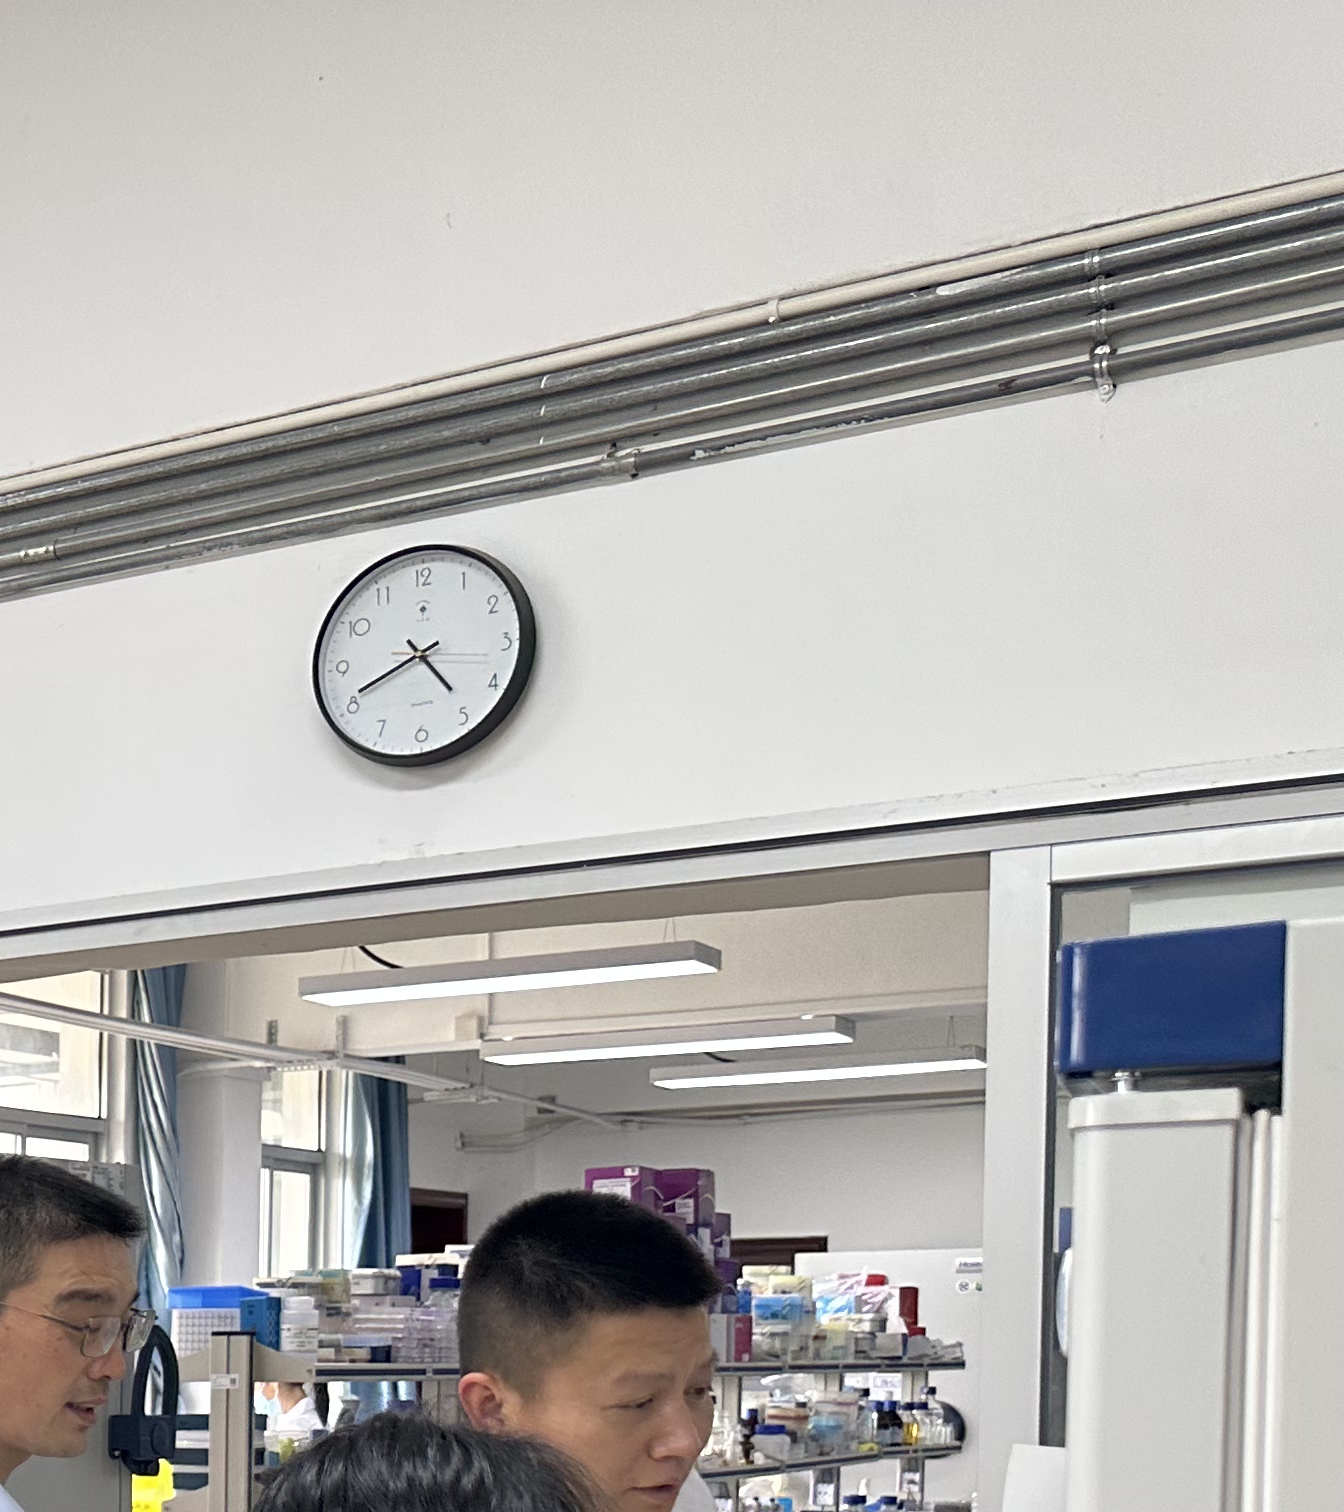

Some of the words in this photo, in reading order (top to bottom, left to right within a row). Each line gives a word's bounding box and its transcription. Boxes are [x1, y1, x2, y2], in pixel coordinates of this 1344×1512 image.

[415, 567, 432, 588] 12
[376, 586, 390, 606] 11
[487, 594, 499, 614] 2
[348, 617, 371, 638] 10
[500, 632, 513, 651] 3
[335, 660, 350, 677] 9
[487, 672, 499, 691] 4
[346, 695, 360, 714] 8
[458, 706, 469, 726] 5
[376, 719, 387, 737] 7
[414, 725, 429, 743] 6
